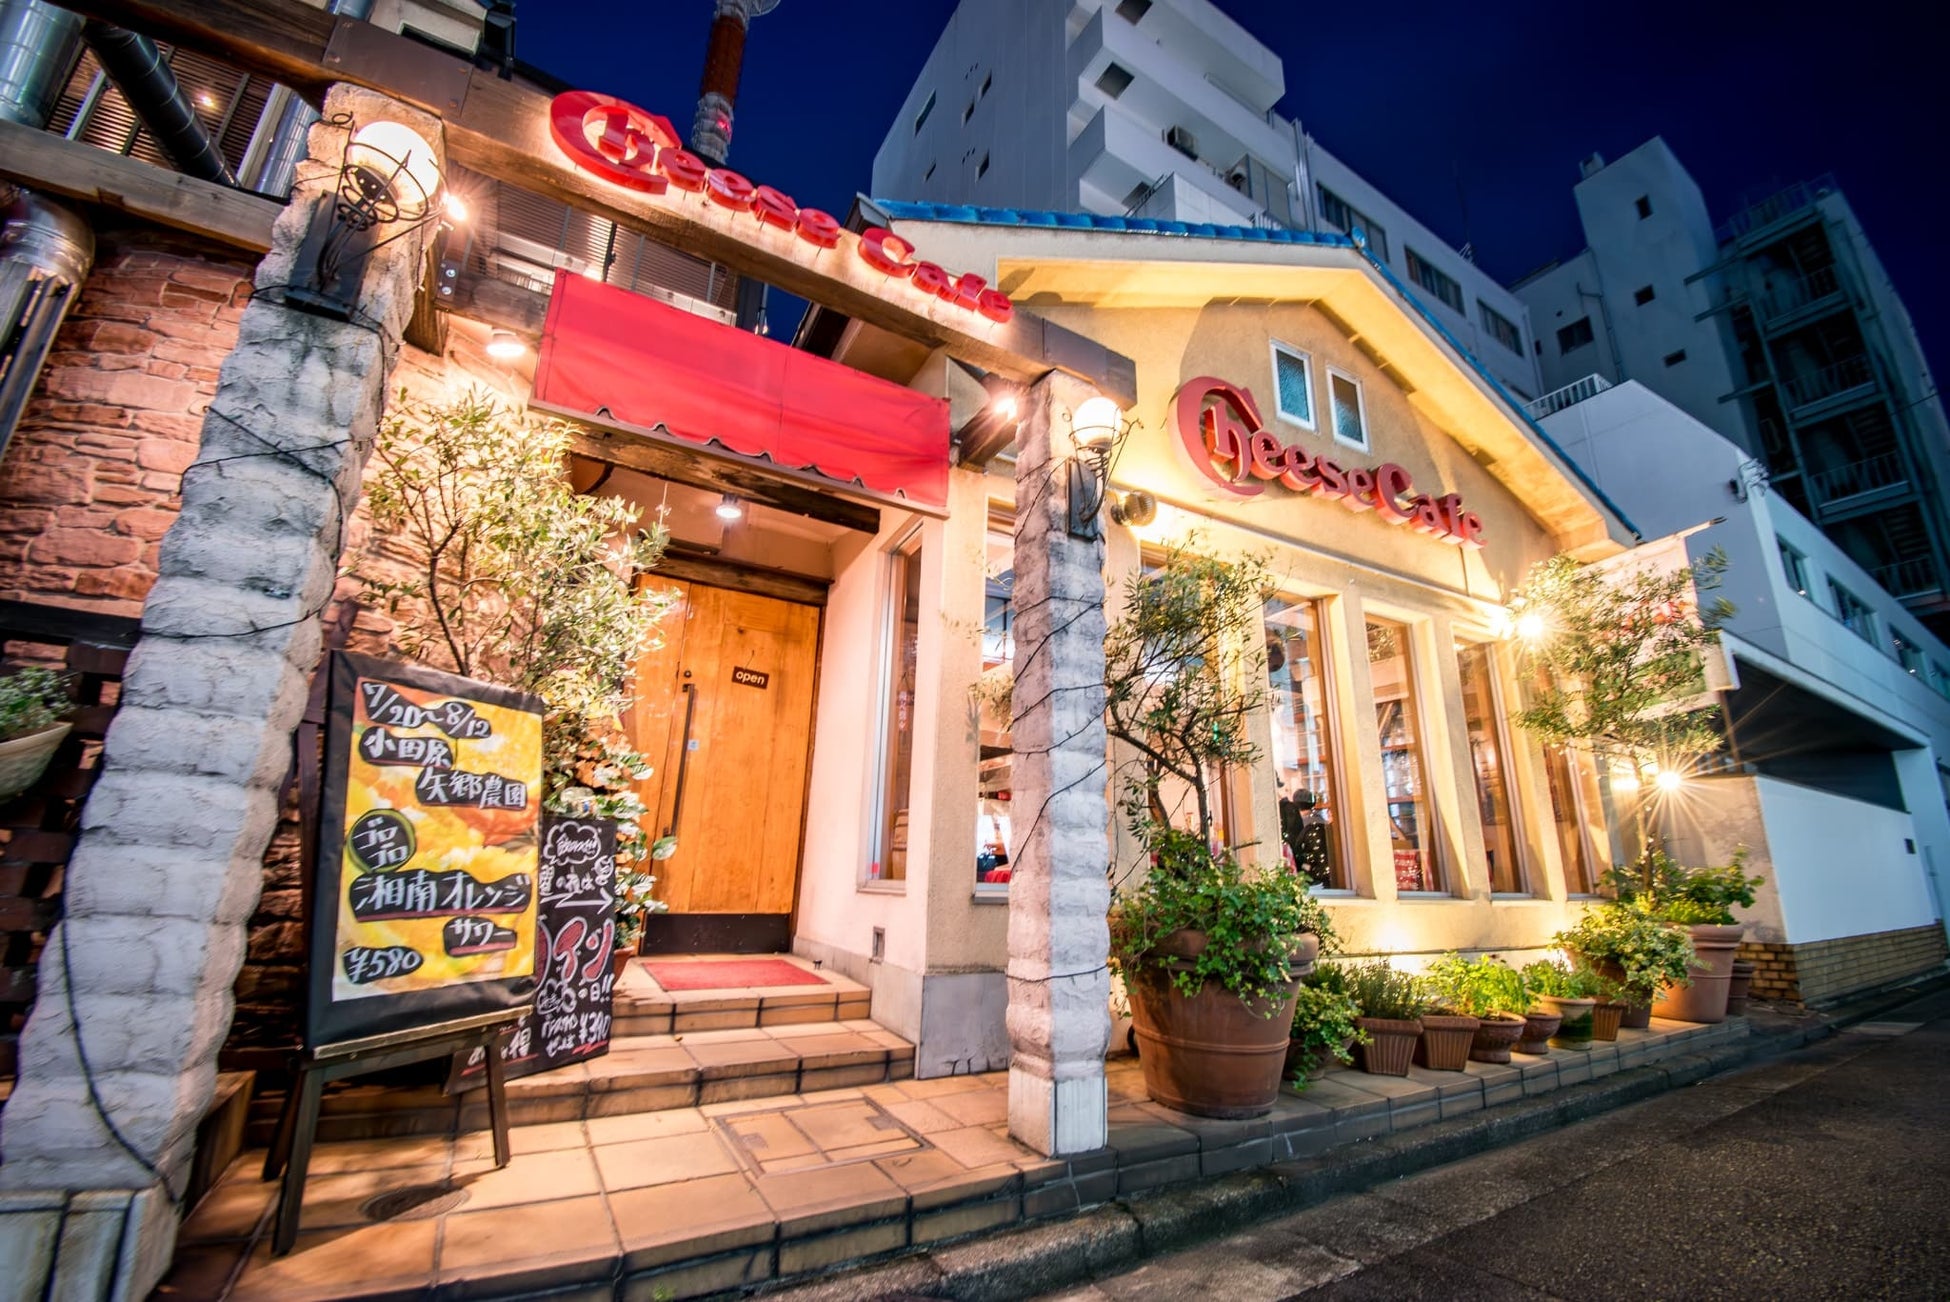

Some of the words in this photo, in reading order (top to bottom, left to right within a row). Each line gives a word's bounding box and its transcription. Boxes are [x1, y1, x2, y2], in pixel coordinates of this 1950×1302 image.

[550, 90, 840, 249] Cheese
[858, 227, 1013, 324] Cafe
[735, 670, 765, 686] open
[363, 727, 451, 768] 小田原
[417, 765, 527, 809] 矢郷農園
[354, 869, 531, 912] 湘南オレンジ
[448, 917, 513, 946] サワー
[343, 946, 420, 984] ¥580
